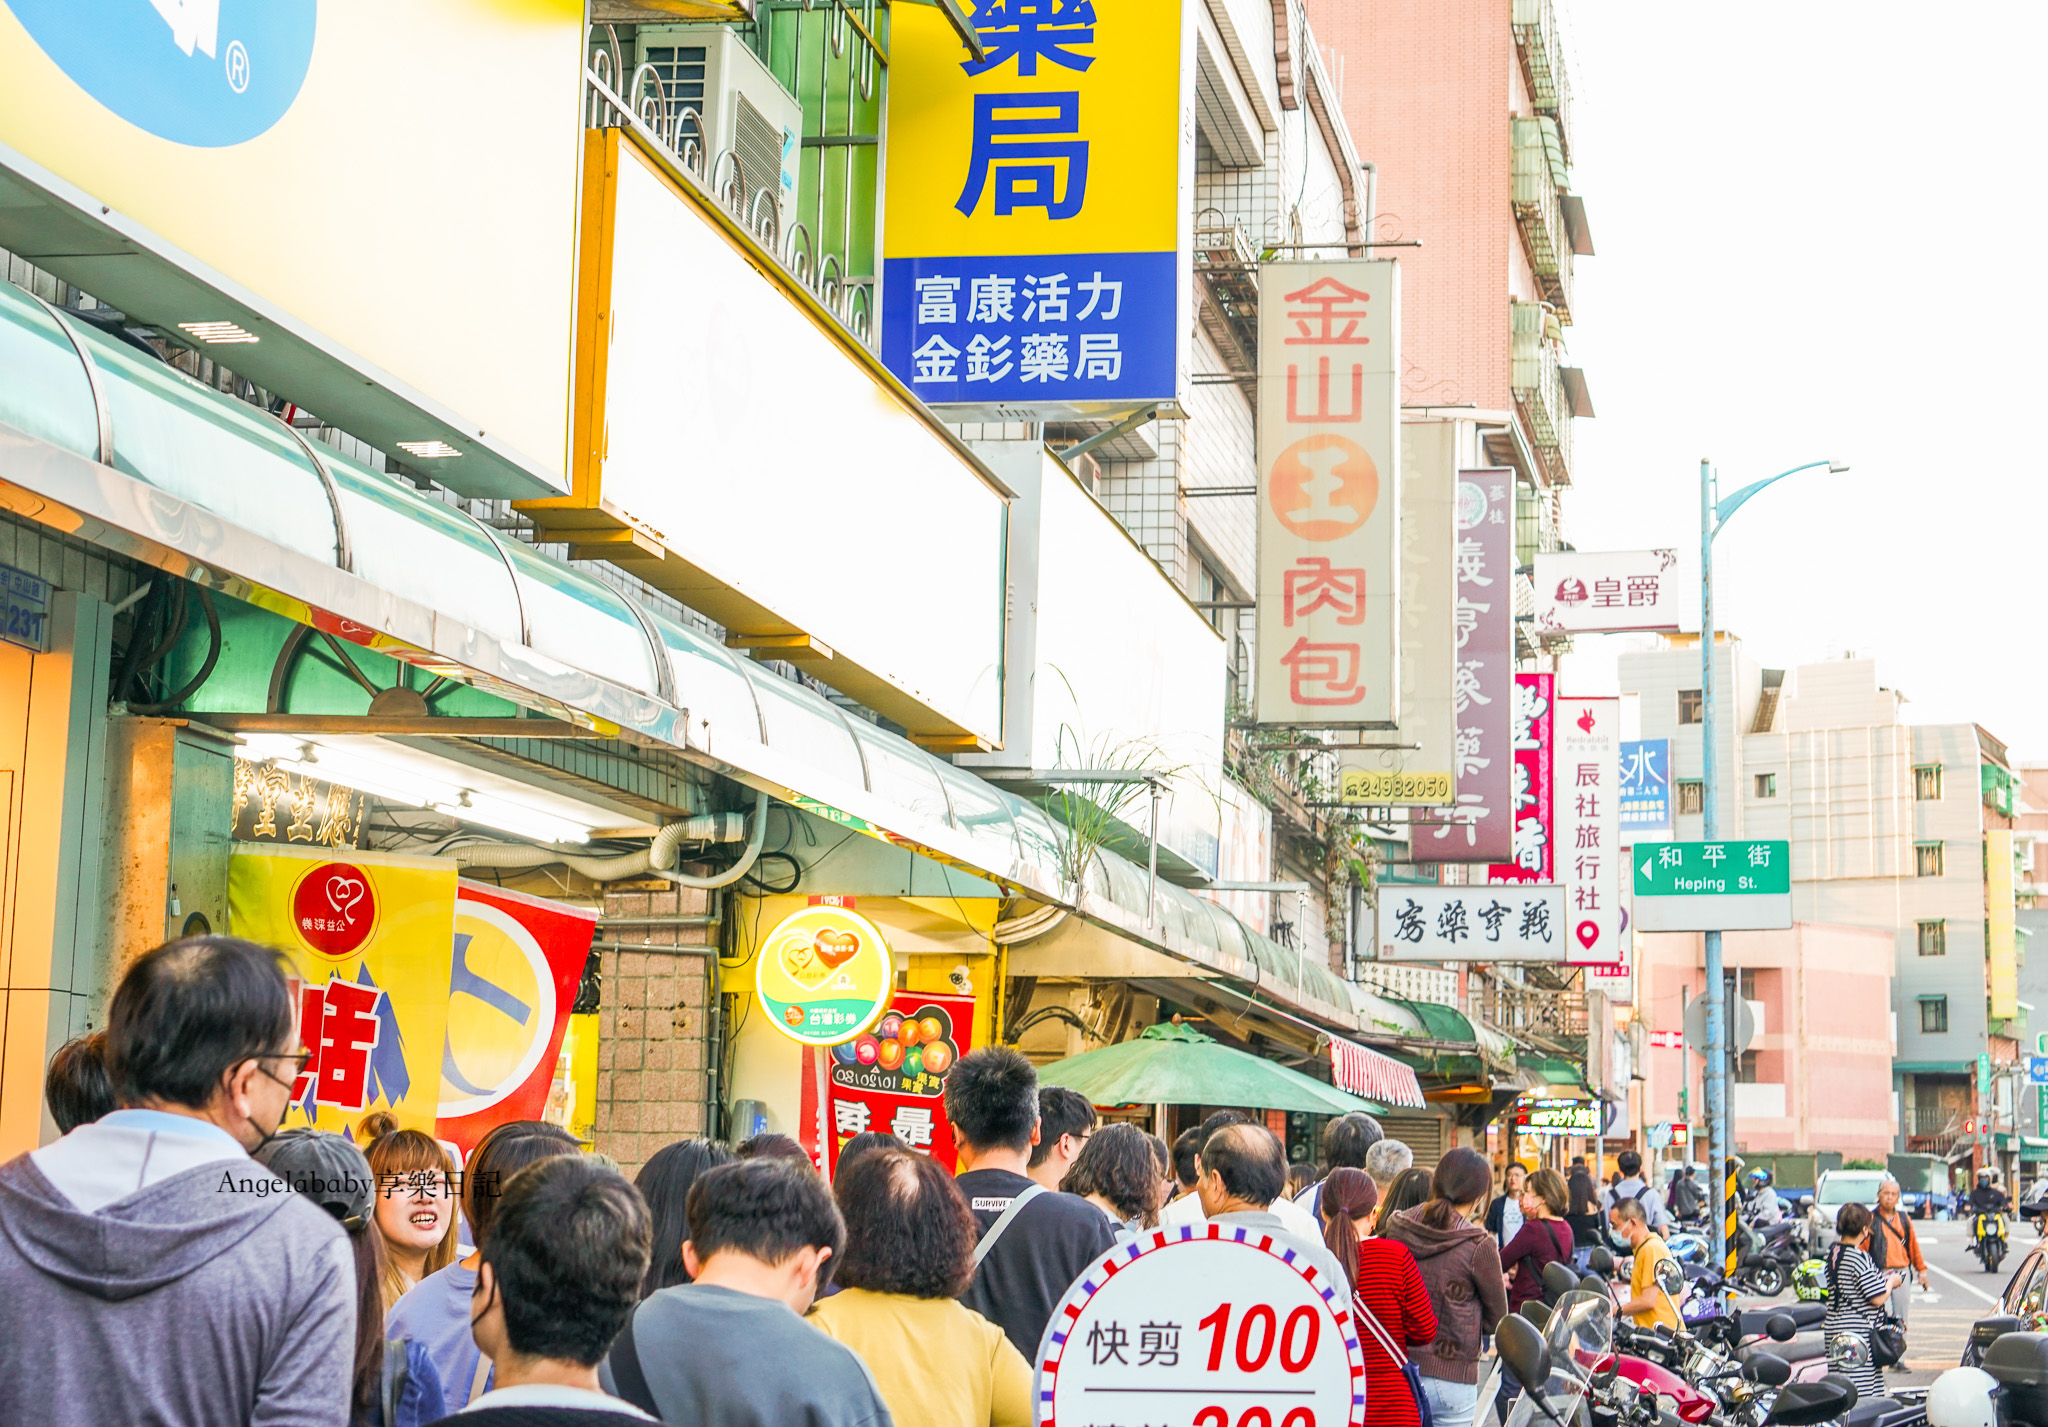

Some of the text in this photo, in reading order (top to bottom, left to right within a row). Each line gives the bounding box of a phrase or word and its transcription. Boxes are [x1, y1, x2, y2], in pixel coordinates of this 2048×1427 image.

[914, 271, 1123, 325] 富康活力
[1592, 575, 1660, 608] 皇爵
[8, 604, 41, 642] 231
[1359, 777, 1448, 798] 24982050
[1575, 763, 1600, 911] 辰社旅行社
[1658, 844, 1772, 869] 和平街
[1674, 876, 1758, 892] Heping St.
[1086, 1302, 1321, 1374] 快剪 100
